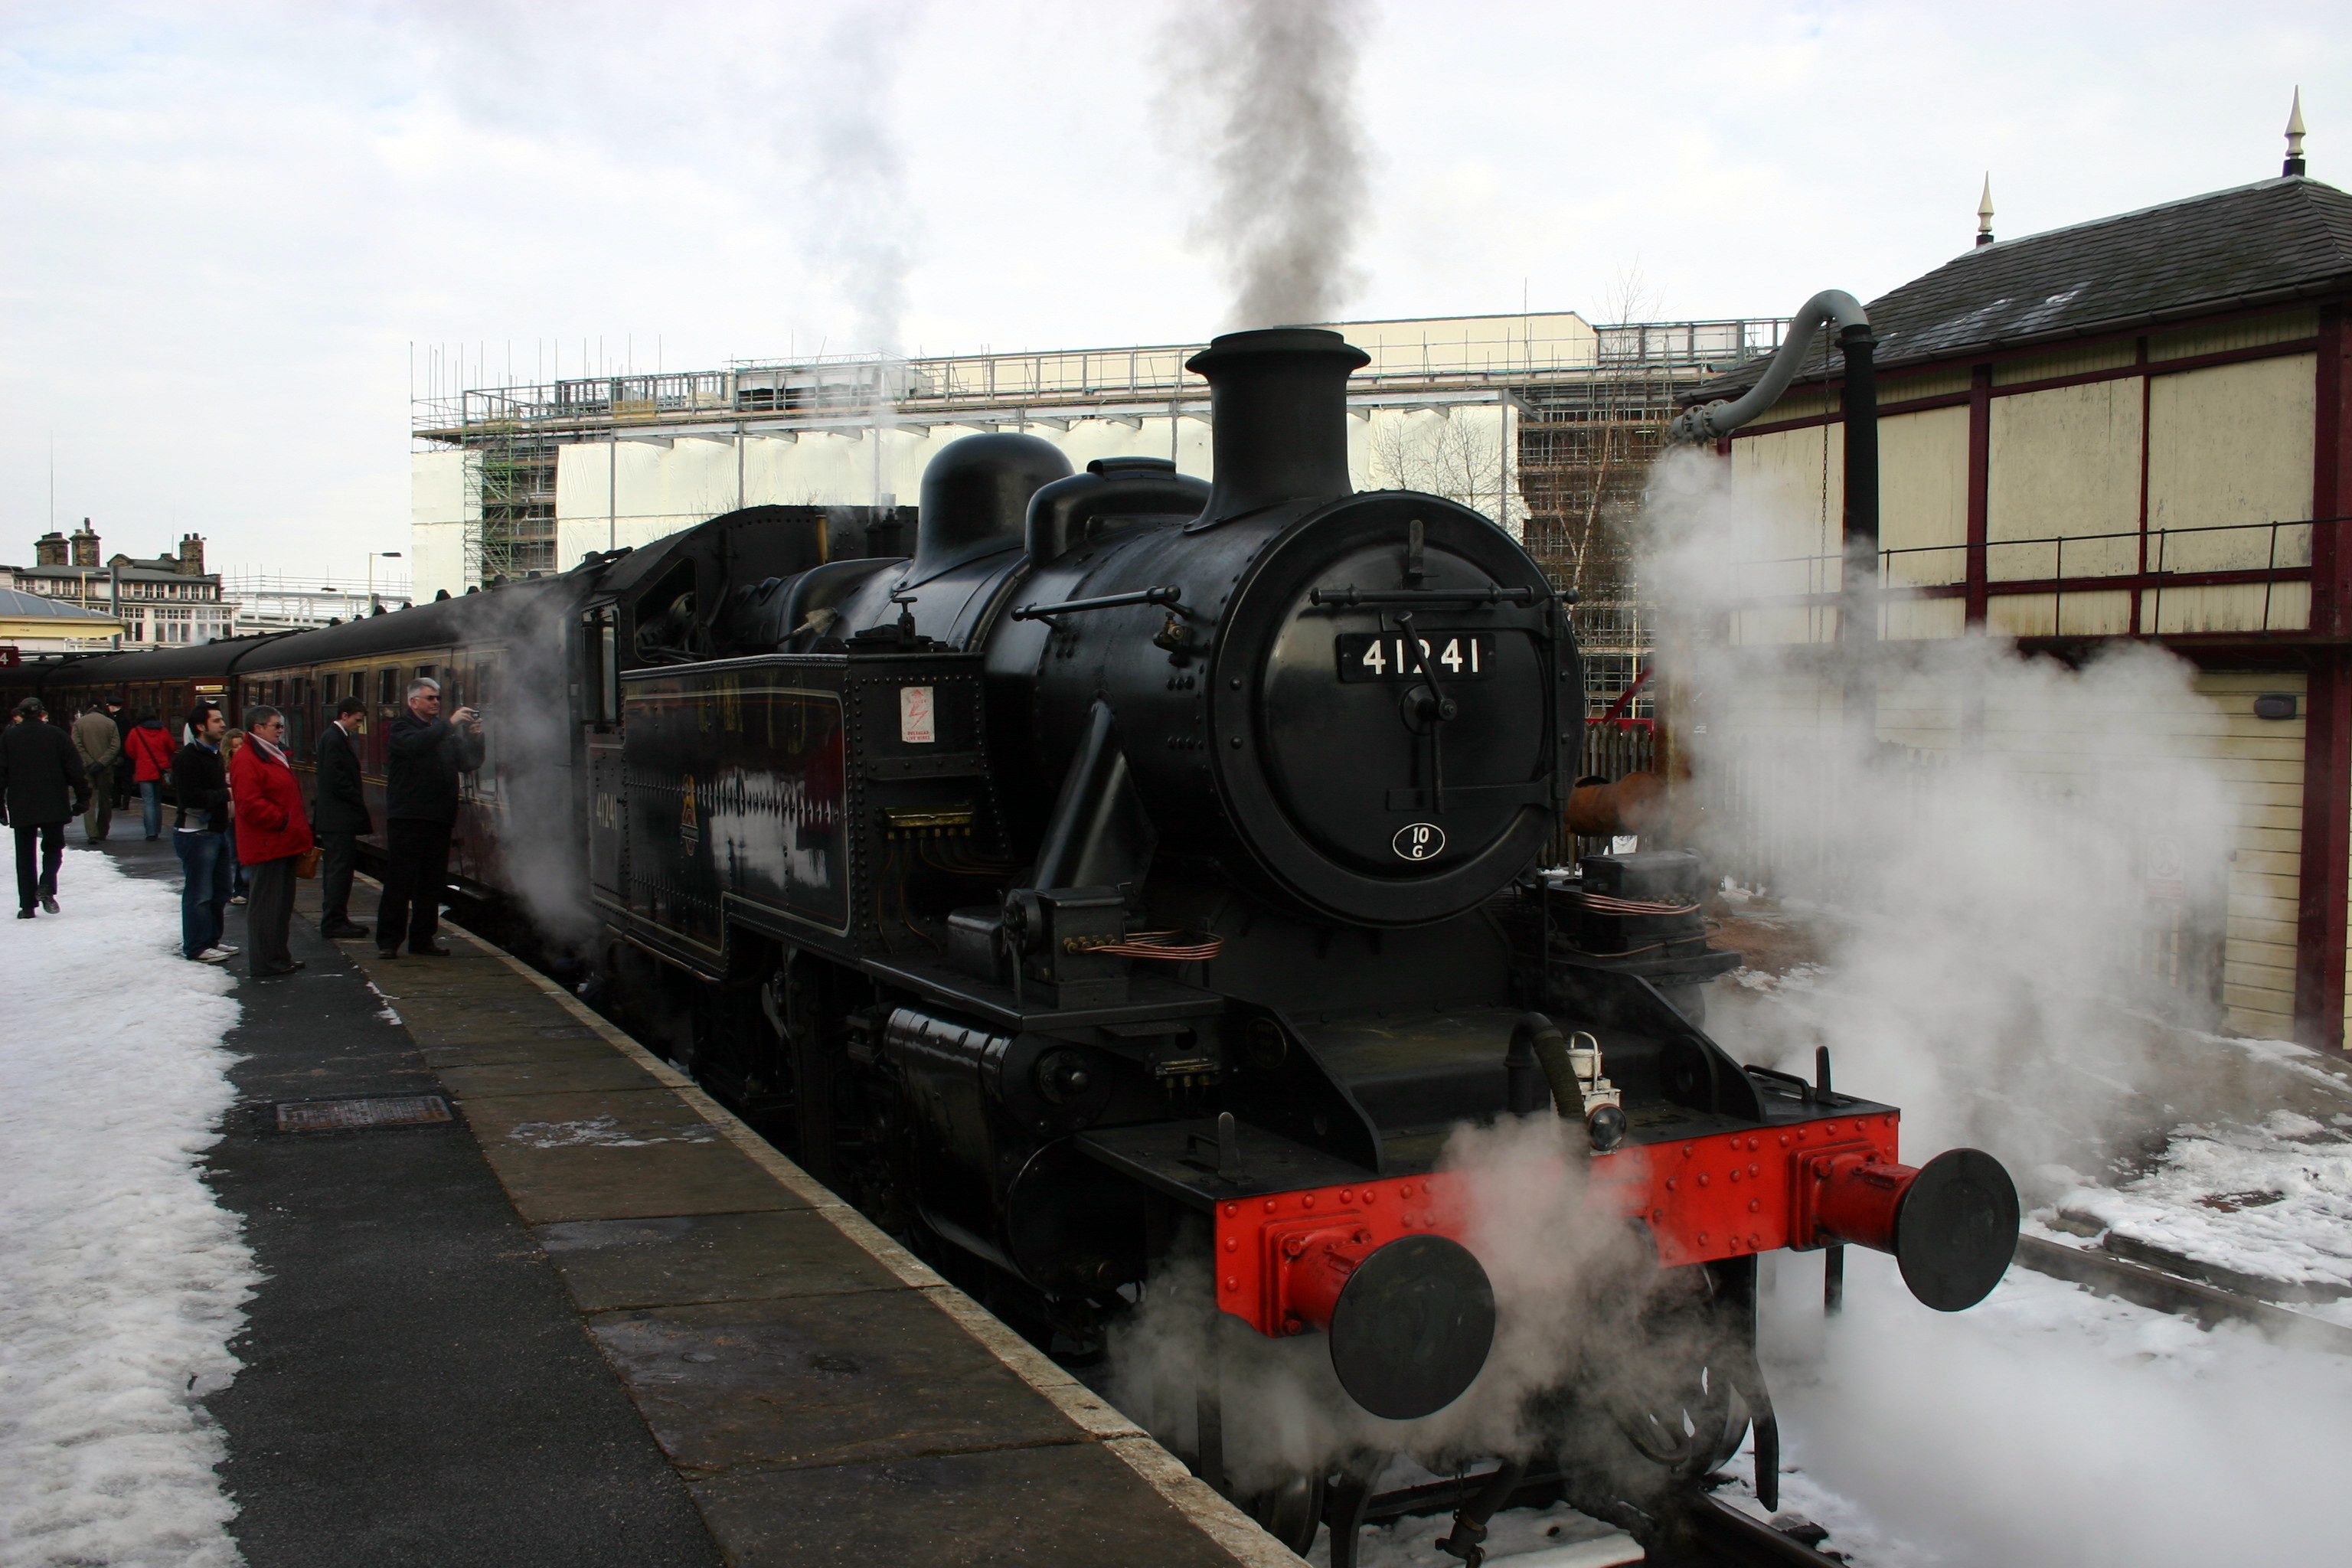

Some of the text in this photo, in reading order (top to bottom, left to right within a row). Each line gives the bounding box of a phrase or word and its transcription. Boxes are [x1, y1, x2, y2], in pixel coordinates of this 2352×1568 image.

[0, 652, 9, 665] 4
[596, 791, 618, 830] 41241
[1413, 827, 1429, 844] 10
[1412, 844, 1423, 858] G
